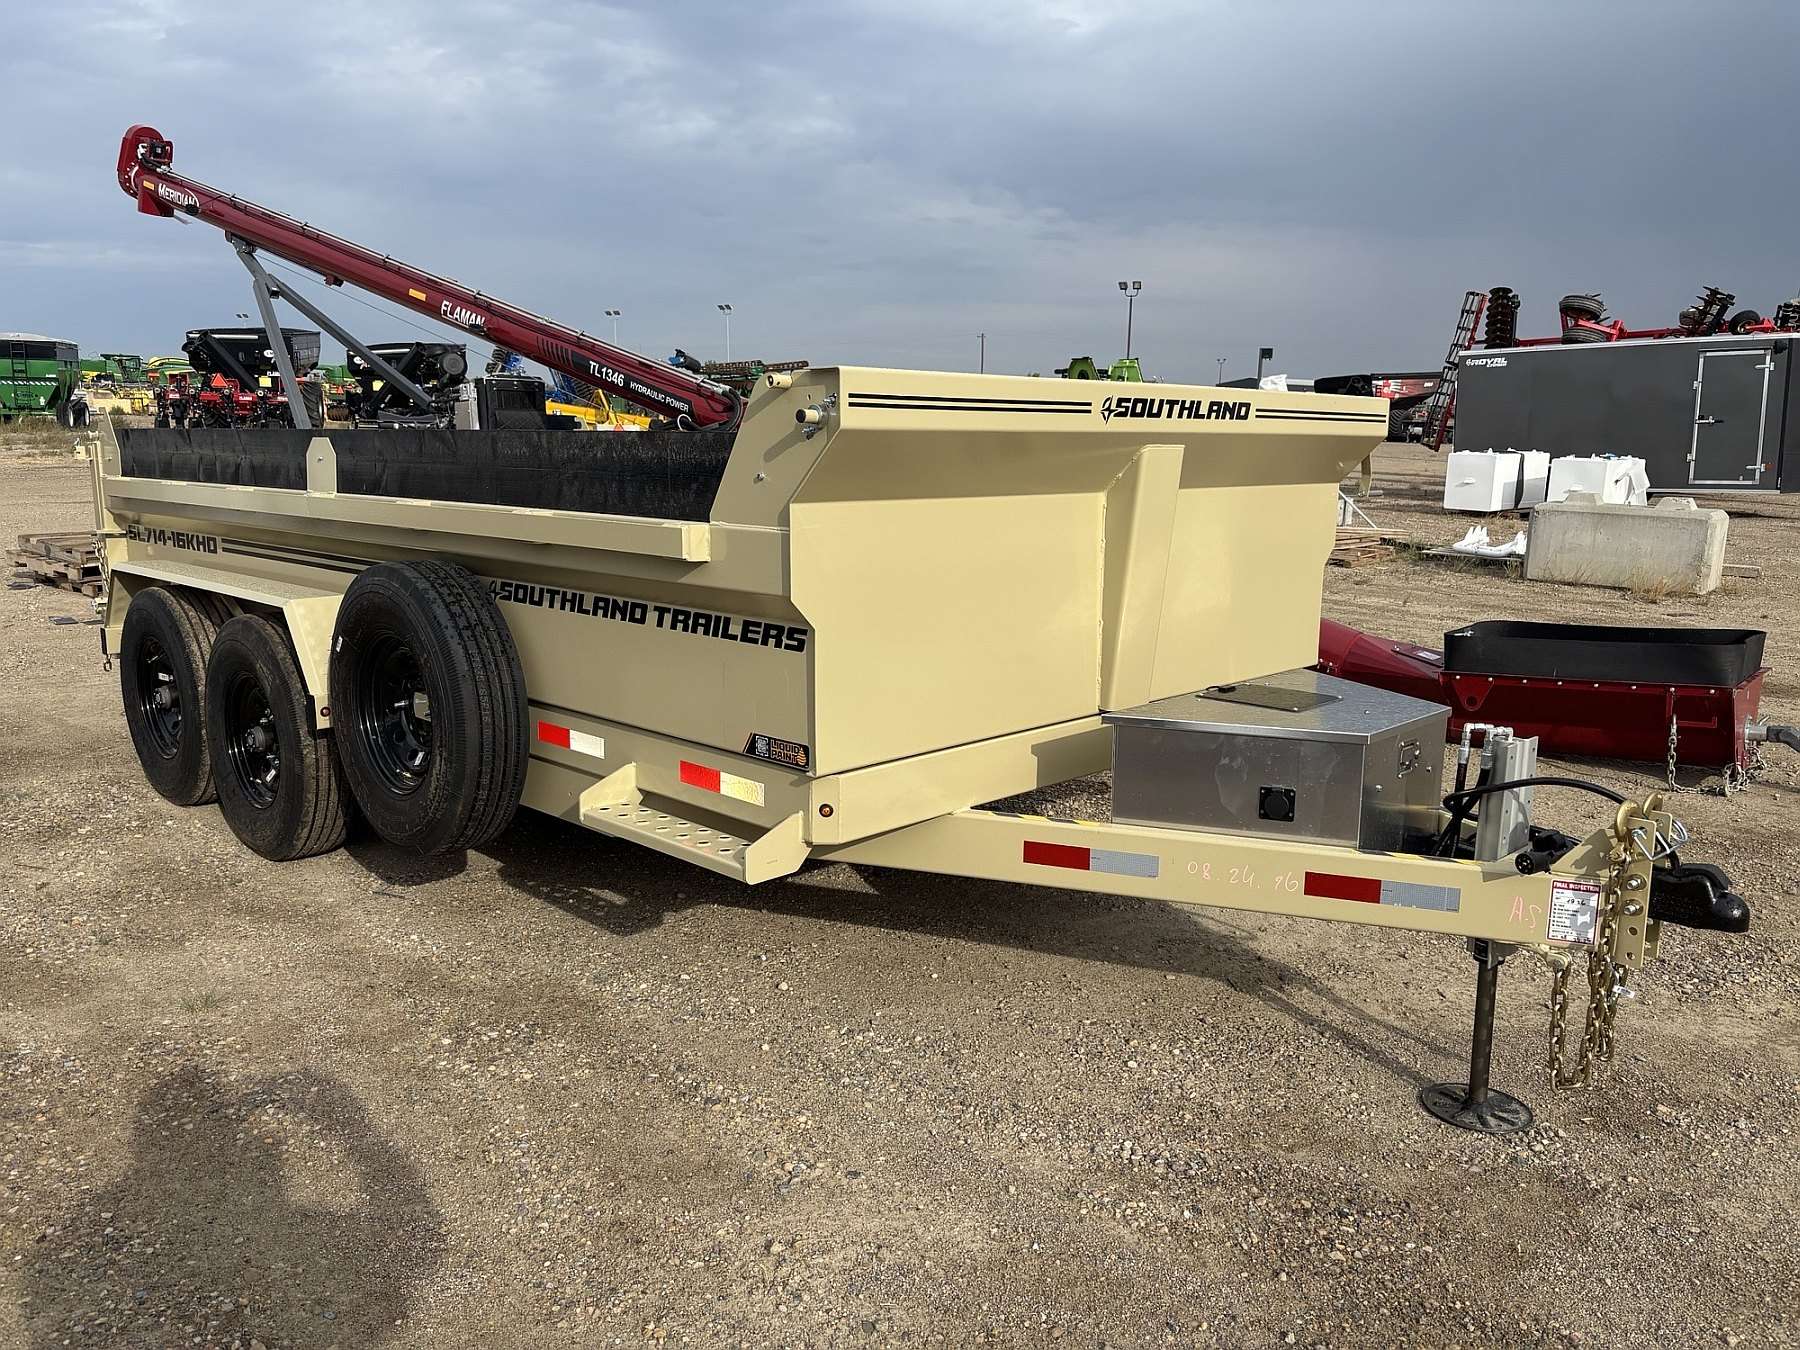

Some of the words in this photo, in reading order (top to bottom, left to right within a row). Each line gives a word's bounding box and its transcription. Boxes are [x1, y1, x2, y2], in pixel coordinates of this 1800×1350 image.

[158, 183, 195, 206] MERIDIAN
[441, 300, 485, 326] FLAMAN
[589, 360, 625, 387] TL1346
[630, 381, 665, 402] HYDRAULIC
[665, 396, 689, 413] POWER
[1113, 397, 1251, 421] SOUTHLAND
[499, 581, 650, 625] SOUTHLAND
[652, 605, 809, 653] TRAILERS
[770, 739, 800, 754] LIQUID
[770, 749, 798, 764] PAINT
